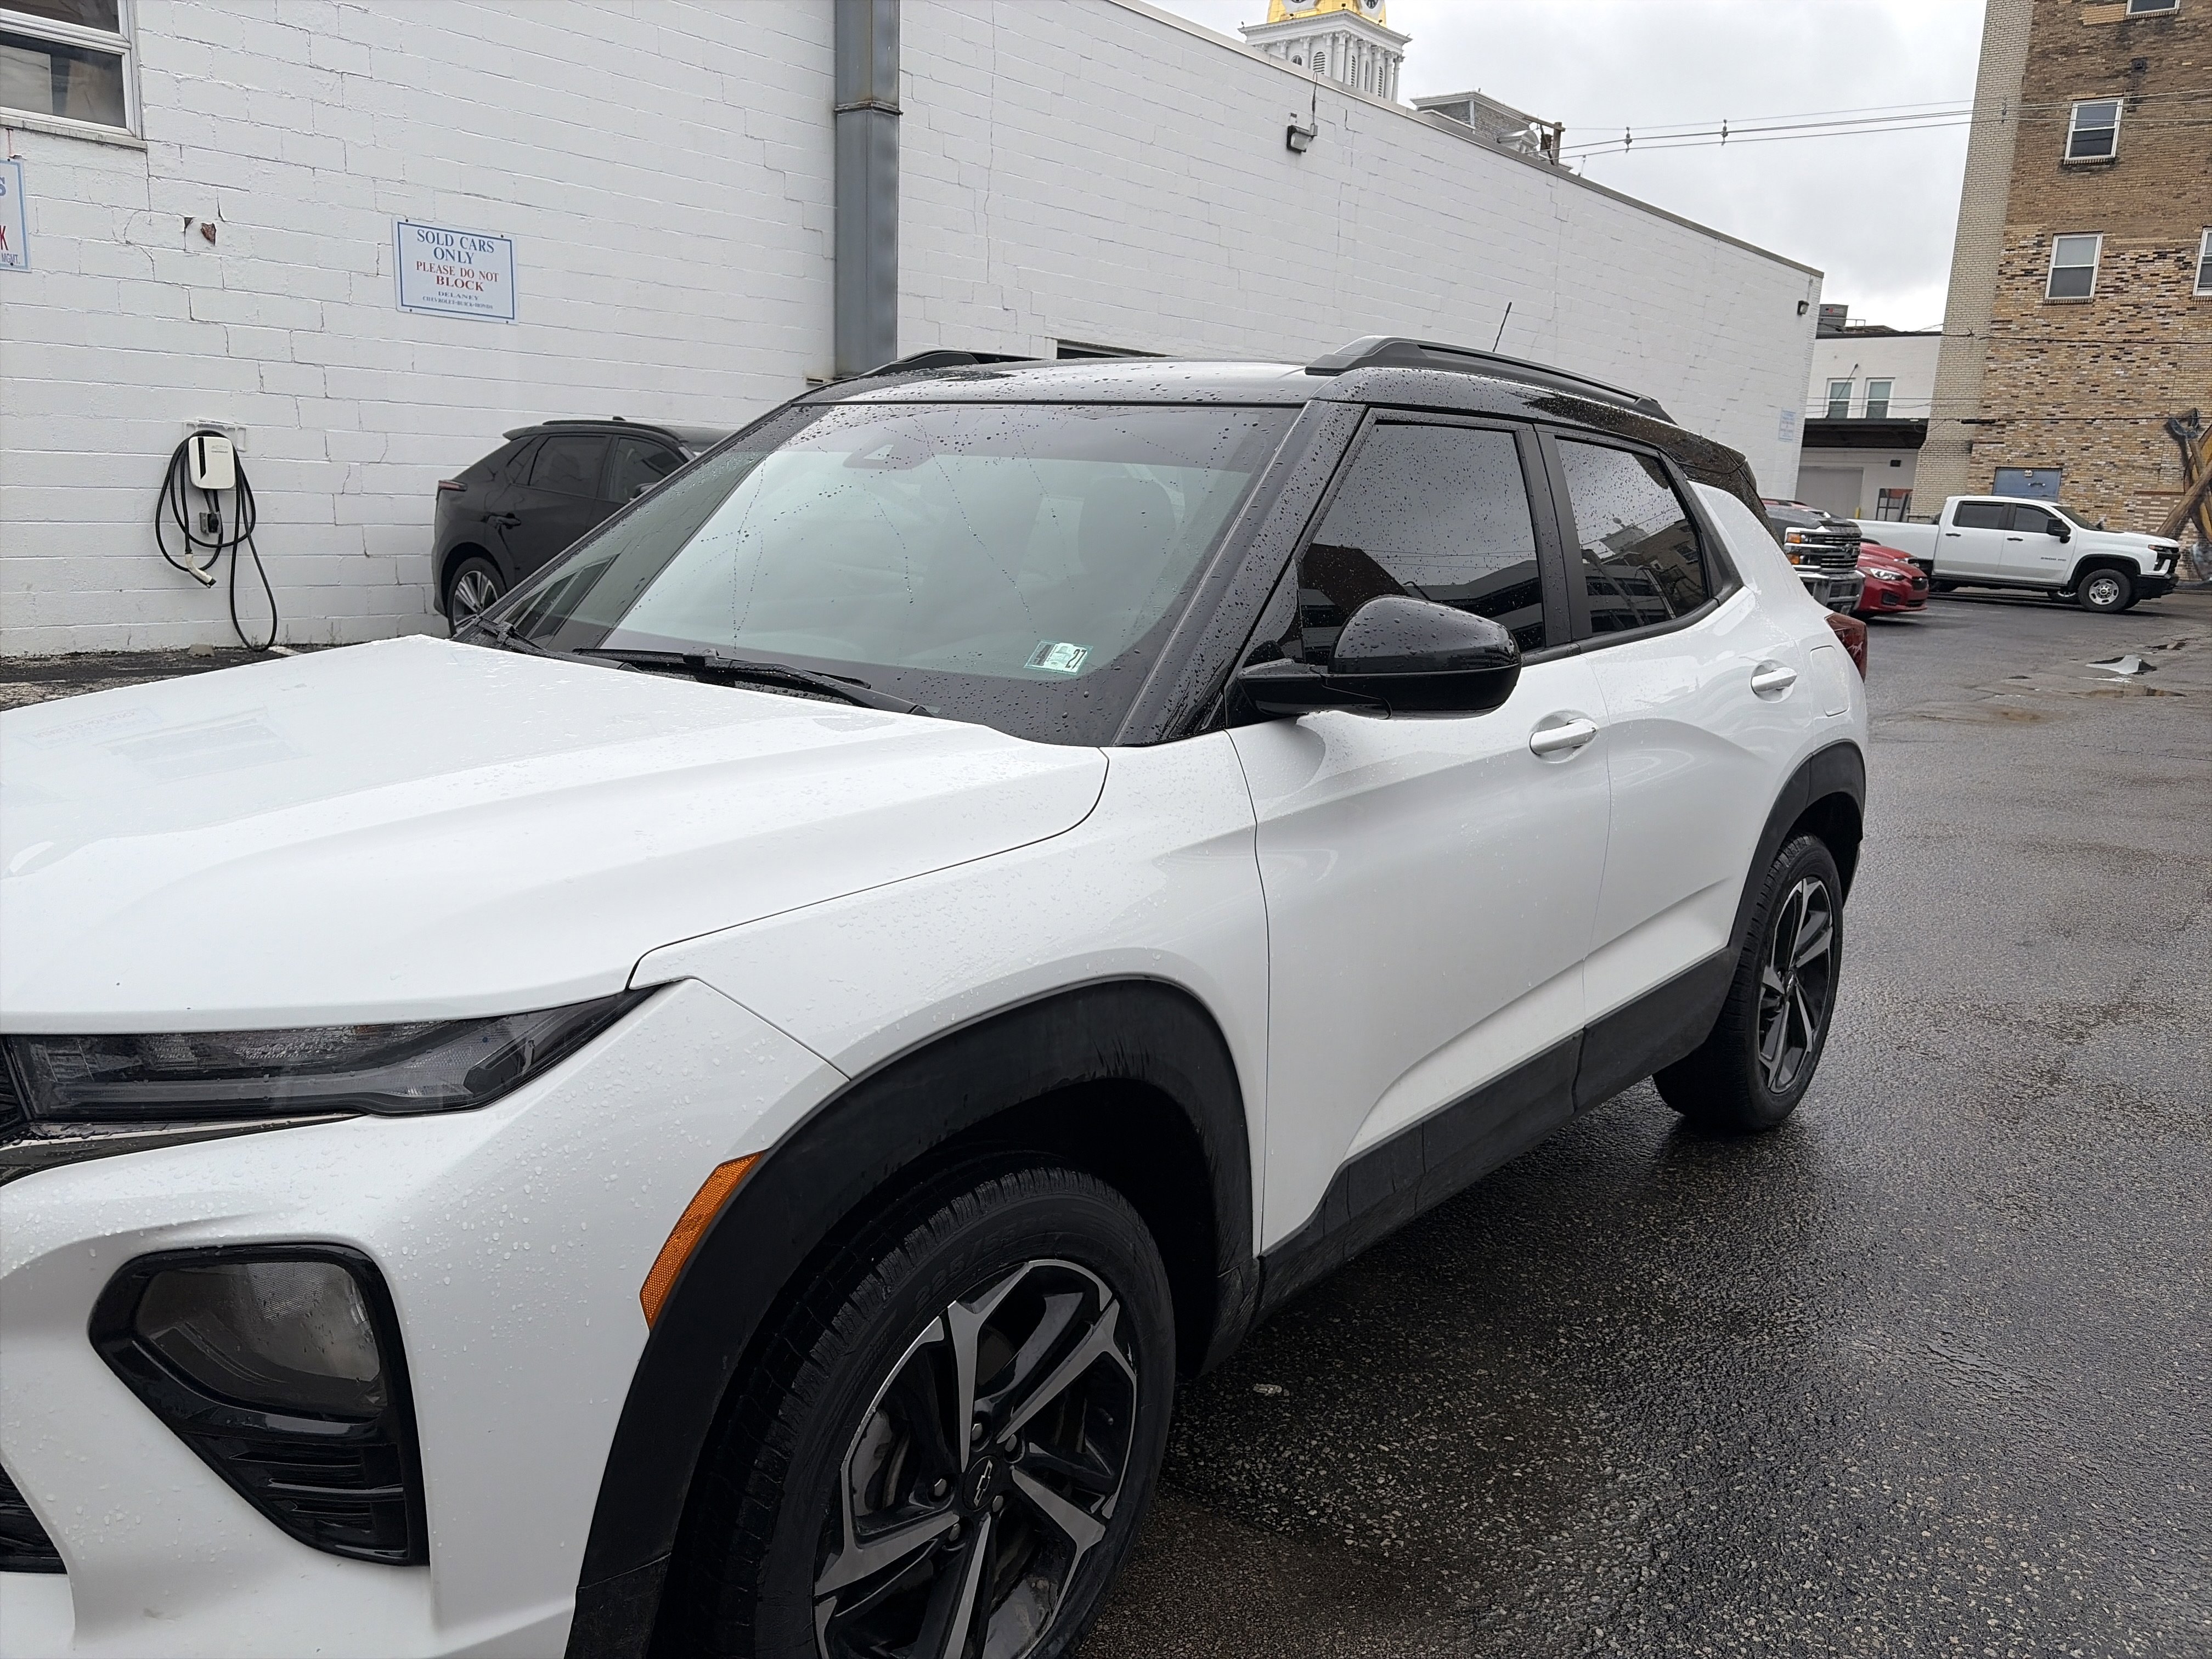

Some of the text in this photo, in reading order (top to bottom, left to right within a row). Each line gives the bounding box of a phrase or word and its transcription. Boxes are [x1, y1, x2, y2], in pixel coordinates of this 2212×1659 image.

[417, 229, 494, 253] SOLD CARS
[433, 247, 475, 264] ONLY
[416, 261, 499, 283] PLEASE DO NOT
[436, 275, 484, 292] BLOCK
[438, 291, 479, 301] DELANEY
[1065, 649, 1087, 669] 27
